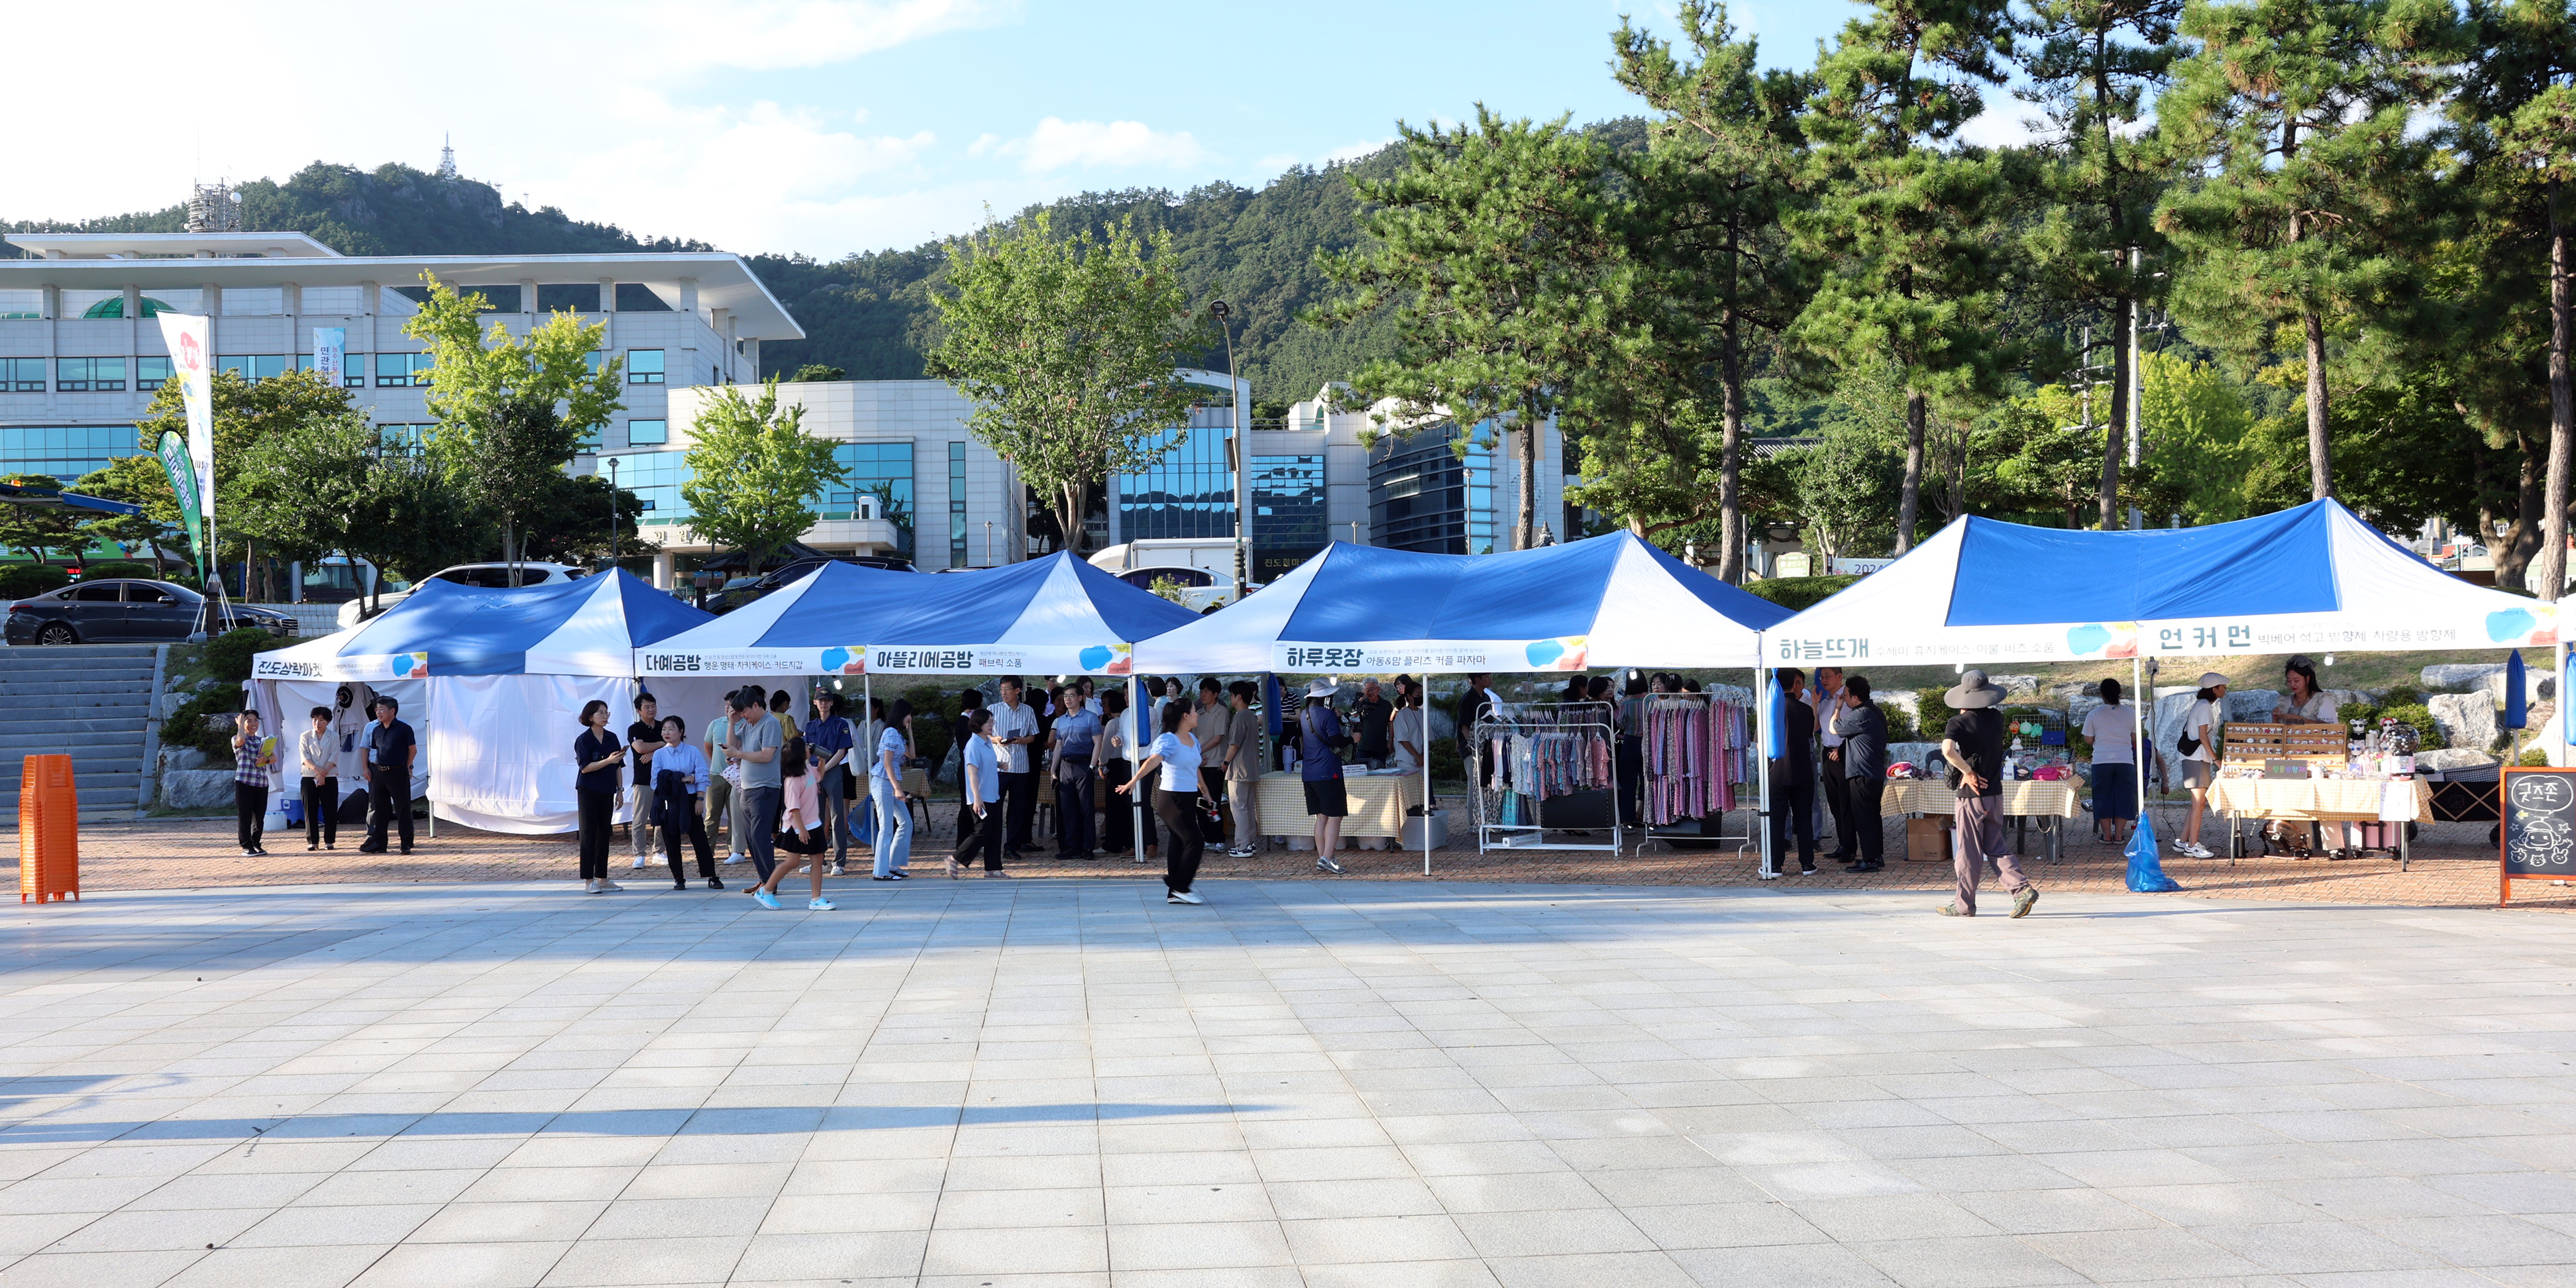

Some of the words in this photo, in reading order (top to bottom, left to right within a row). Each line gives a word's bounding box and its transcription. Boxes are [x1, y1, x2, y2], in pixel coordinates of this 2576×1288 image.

[2258, 632, 2295, 645] 빅베어
[2299, 631, 2324, 643] 석고
[2416, 628, 2455, 641] 방향제
[1780, 638, 1868, 659] 하늘뜨개
[2031, 642, 2055, 654] 소품
[646, 655, 701, 671] 다예공방
[877, 651, 973, 669] 아뜰리에공방
[979, 659, 1003, 667] 패브릭
[1006, 659, 1022, 668] 소품
[1287, 648, 1364, 667] 하루옷장
[1366, 657, 1401, 667] 아동&맘
[1404, 656, 1432, 665] 플리츠
[1436, 656, 1454, 665] 커플
[1457, 655, 1485, 665] 파자마
[258, 661, 323, 677] 진도삼락마켓
[704, 661, 718, 671] 행운
[2518, 782, 2558, 803] 굿즈존
